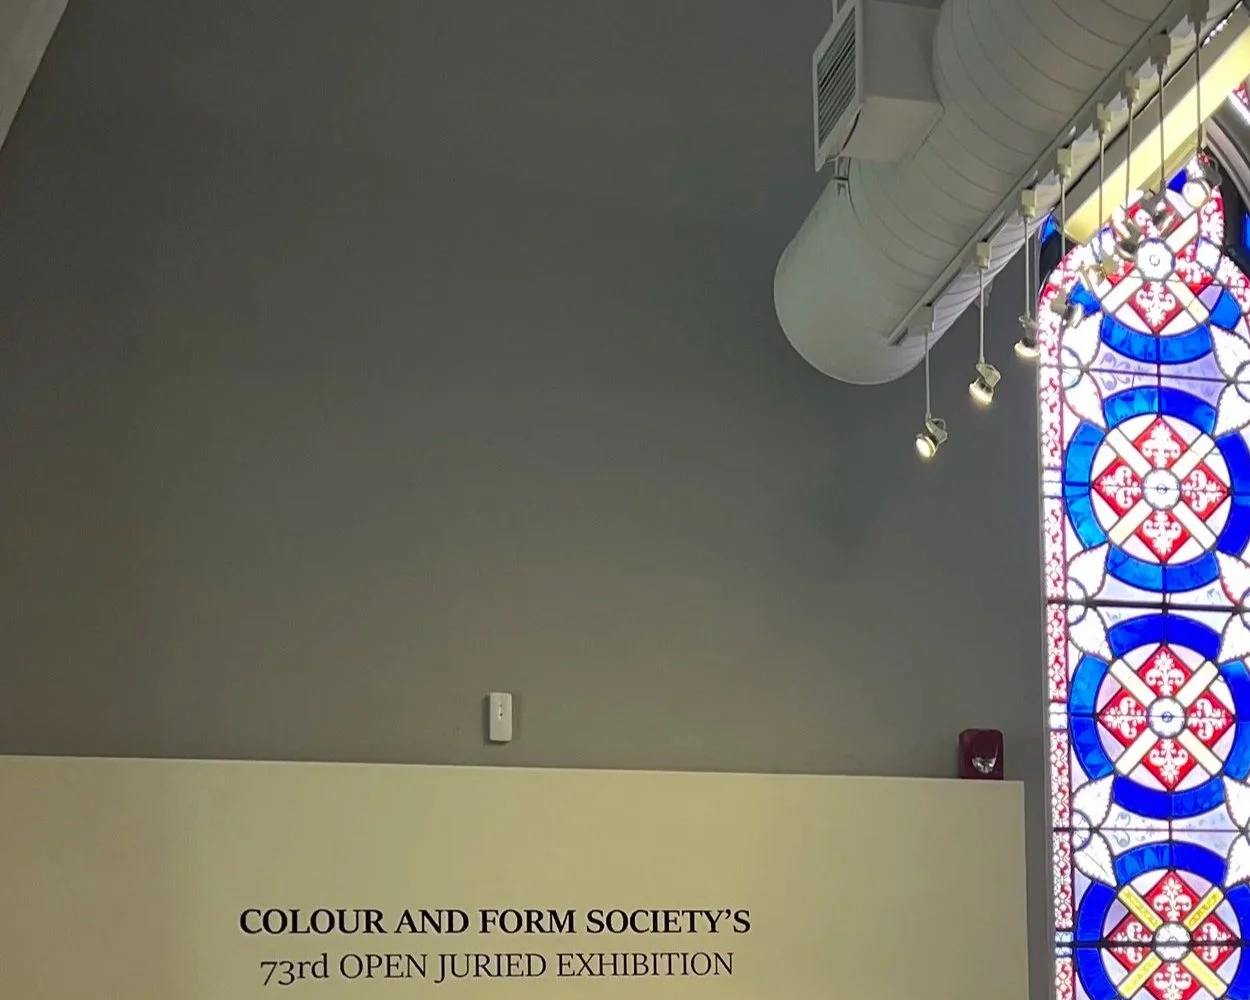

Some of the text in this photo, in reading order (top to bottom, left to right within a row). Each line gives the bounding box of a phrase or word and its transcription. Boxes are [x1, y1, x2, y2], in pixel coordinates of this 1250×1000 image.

[239, 908, 751, 934] COLOUR AND FORM SOCIETY’S
[259, 951, 734, 987] 73rd OPEN JURIED EXHIBITION
